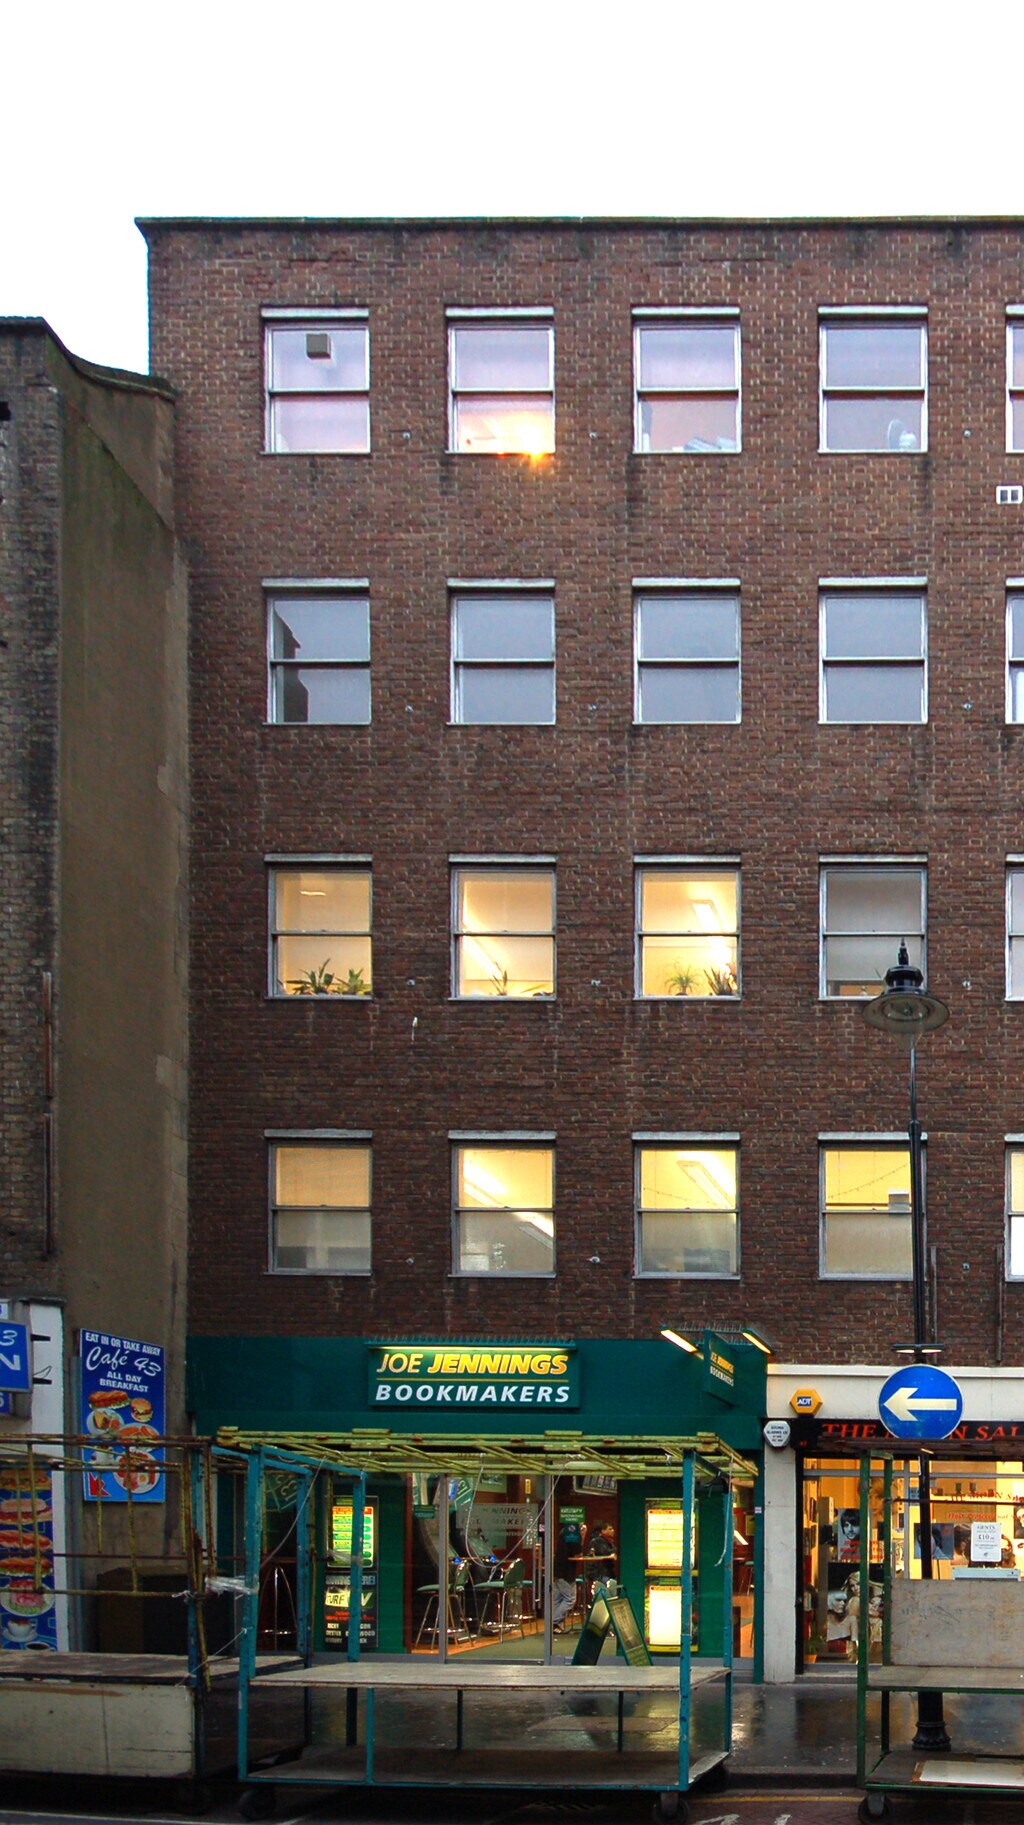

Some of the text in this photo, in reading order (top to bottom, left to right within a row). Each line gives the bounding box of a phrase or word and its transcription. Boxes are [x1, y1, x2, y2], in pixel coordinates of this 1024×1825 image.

[85, 1331, 161, 1356] EAT IN OR TAKE AWAY
[86, 1346, 162, 1376] Café 43
[376, 1353, 569, 1375] JOE JENNINGS
[107, 1370, 142, 1383] ALL DAY
[99, 1378, 149, 1393] BREAKFAST
[375, 1384, 570, 1403] BOOKMAKERS
[797, 1397, 811, 1406] ADT
[822, 1423, 877, 1439] THE
